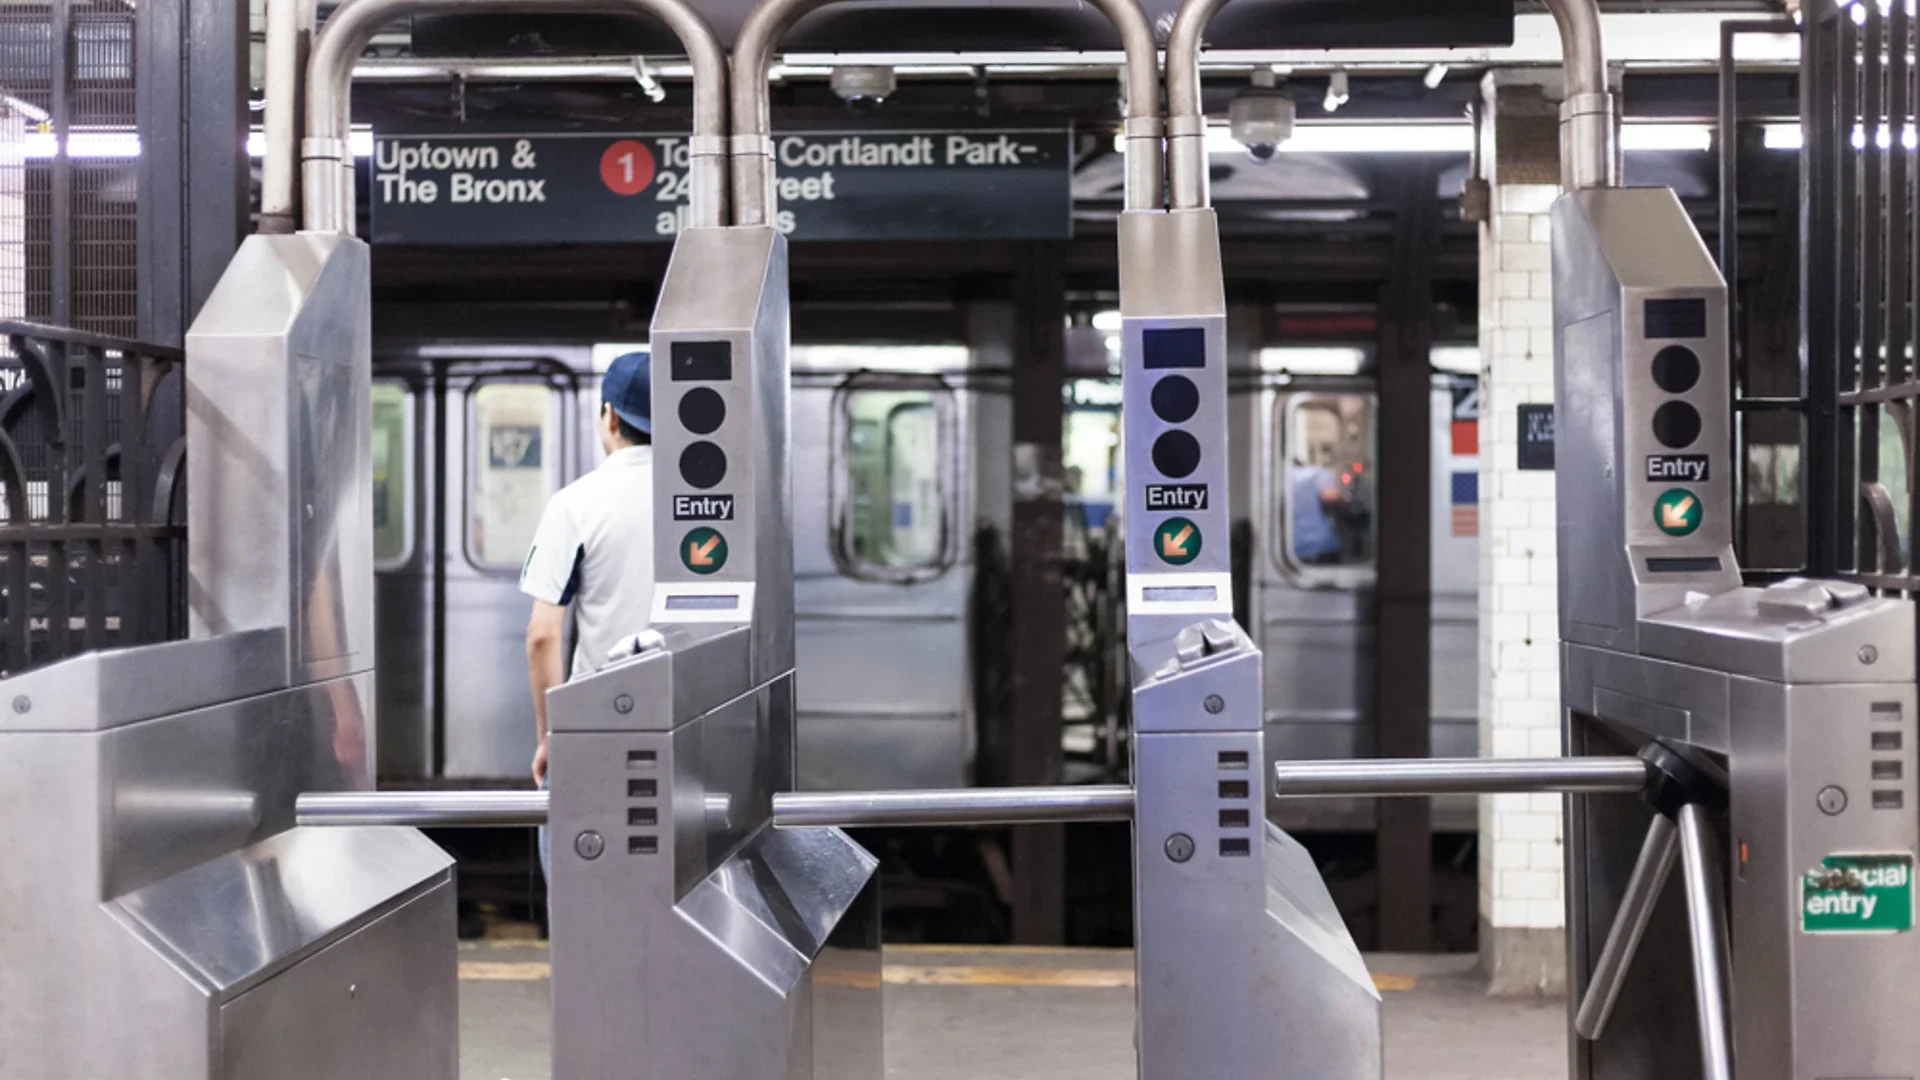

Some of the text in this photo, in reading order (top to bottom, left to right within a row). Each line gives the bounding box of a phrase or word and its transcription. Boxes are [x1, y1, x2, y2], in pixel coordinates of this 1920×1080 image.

[375, 139, 537, 175] Uptown &
[778, 136, 934, 168] Cortlandt
[945, 135, 1038, 166] Park-
[616, 152, 634, 183] 1
[375, 172, 546, 203] The Bronx
[656, 171, 835, 201] 24 reet
[1648, 457, 1706, 481] Entry
[675, 496, 732, 520] Entry
[1147, 486, 1206, 510] Entry
[1807, 890, 1878, 919] entry
